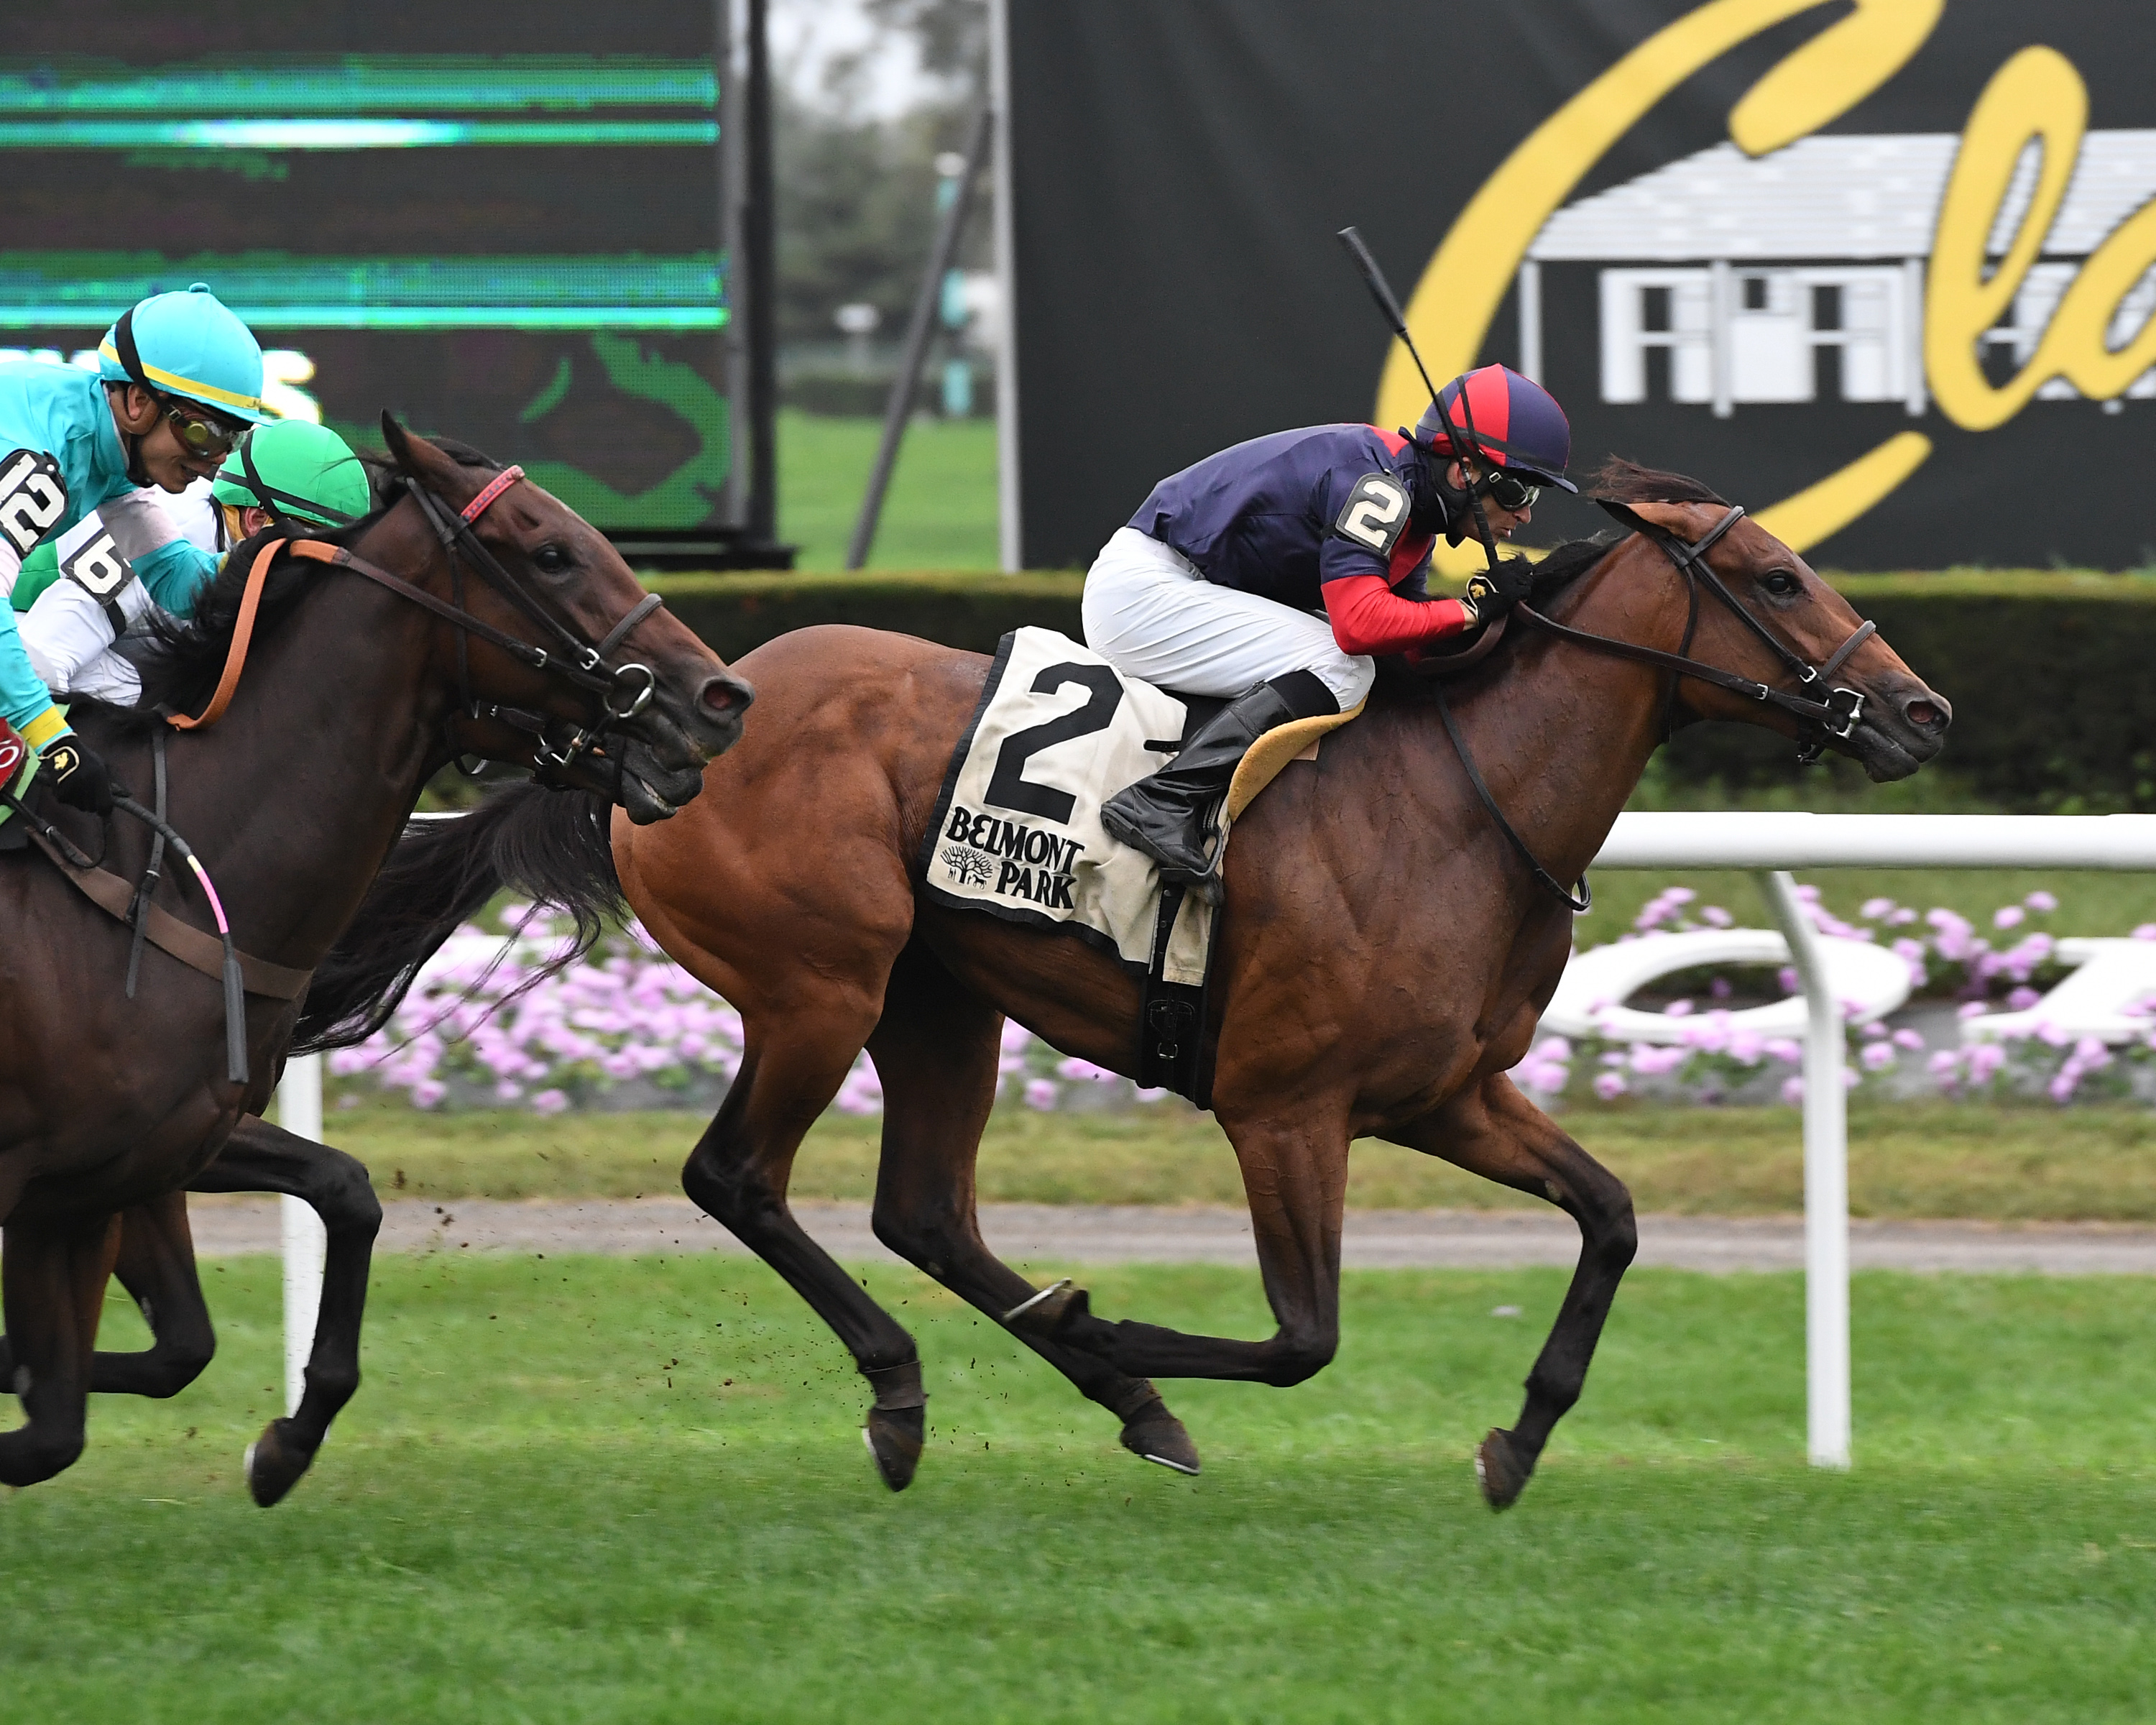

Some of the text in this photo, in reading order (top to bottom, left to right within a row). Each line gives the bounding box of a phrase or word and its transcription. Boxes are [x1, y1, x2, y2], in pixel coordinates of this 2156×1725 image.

[0, 454, 65, 553] 12
[1345, 480, 1404, 548] 2
[73, 533, 123, 594] 6
[983, 661, 1124, 825] 2
[945, 806, 1085, 875] BELMONT
[995, 861, 1077, 909] PARK
